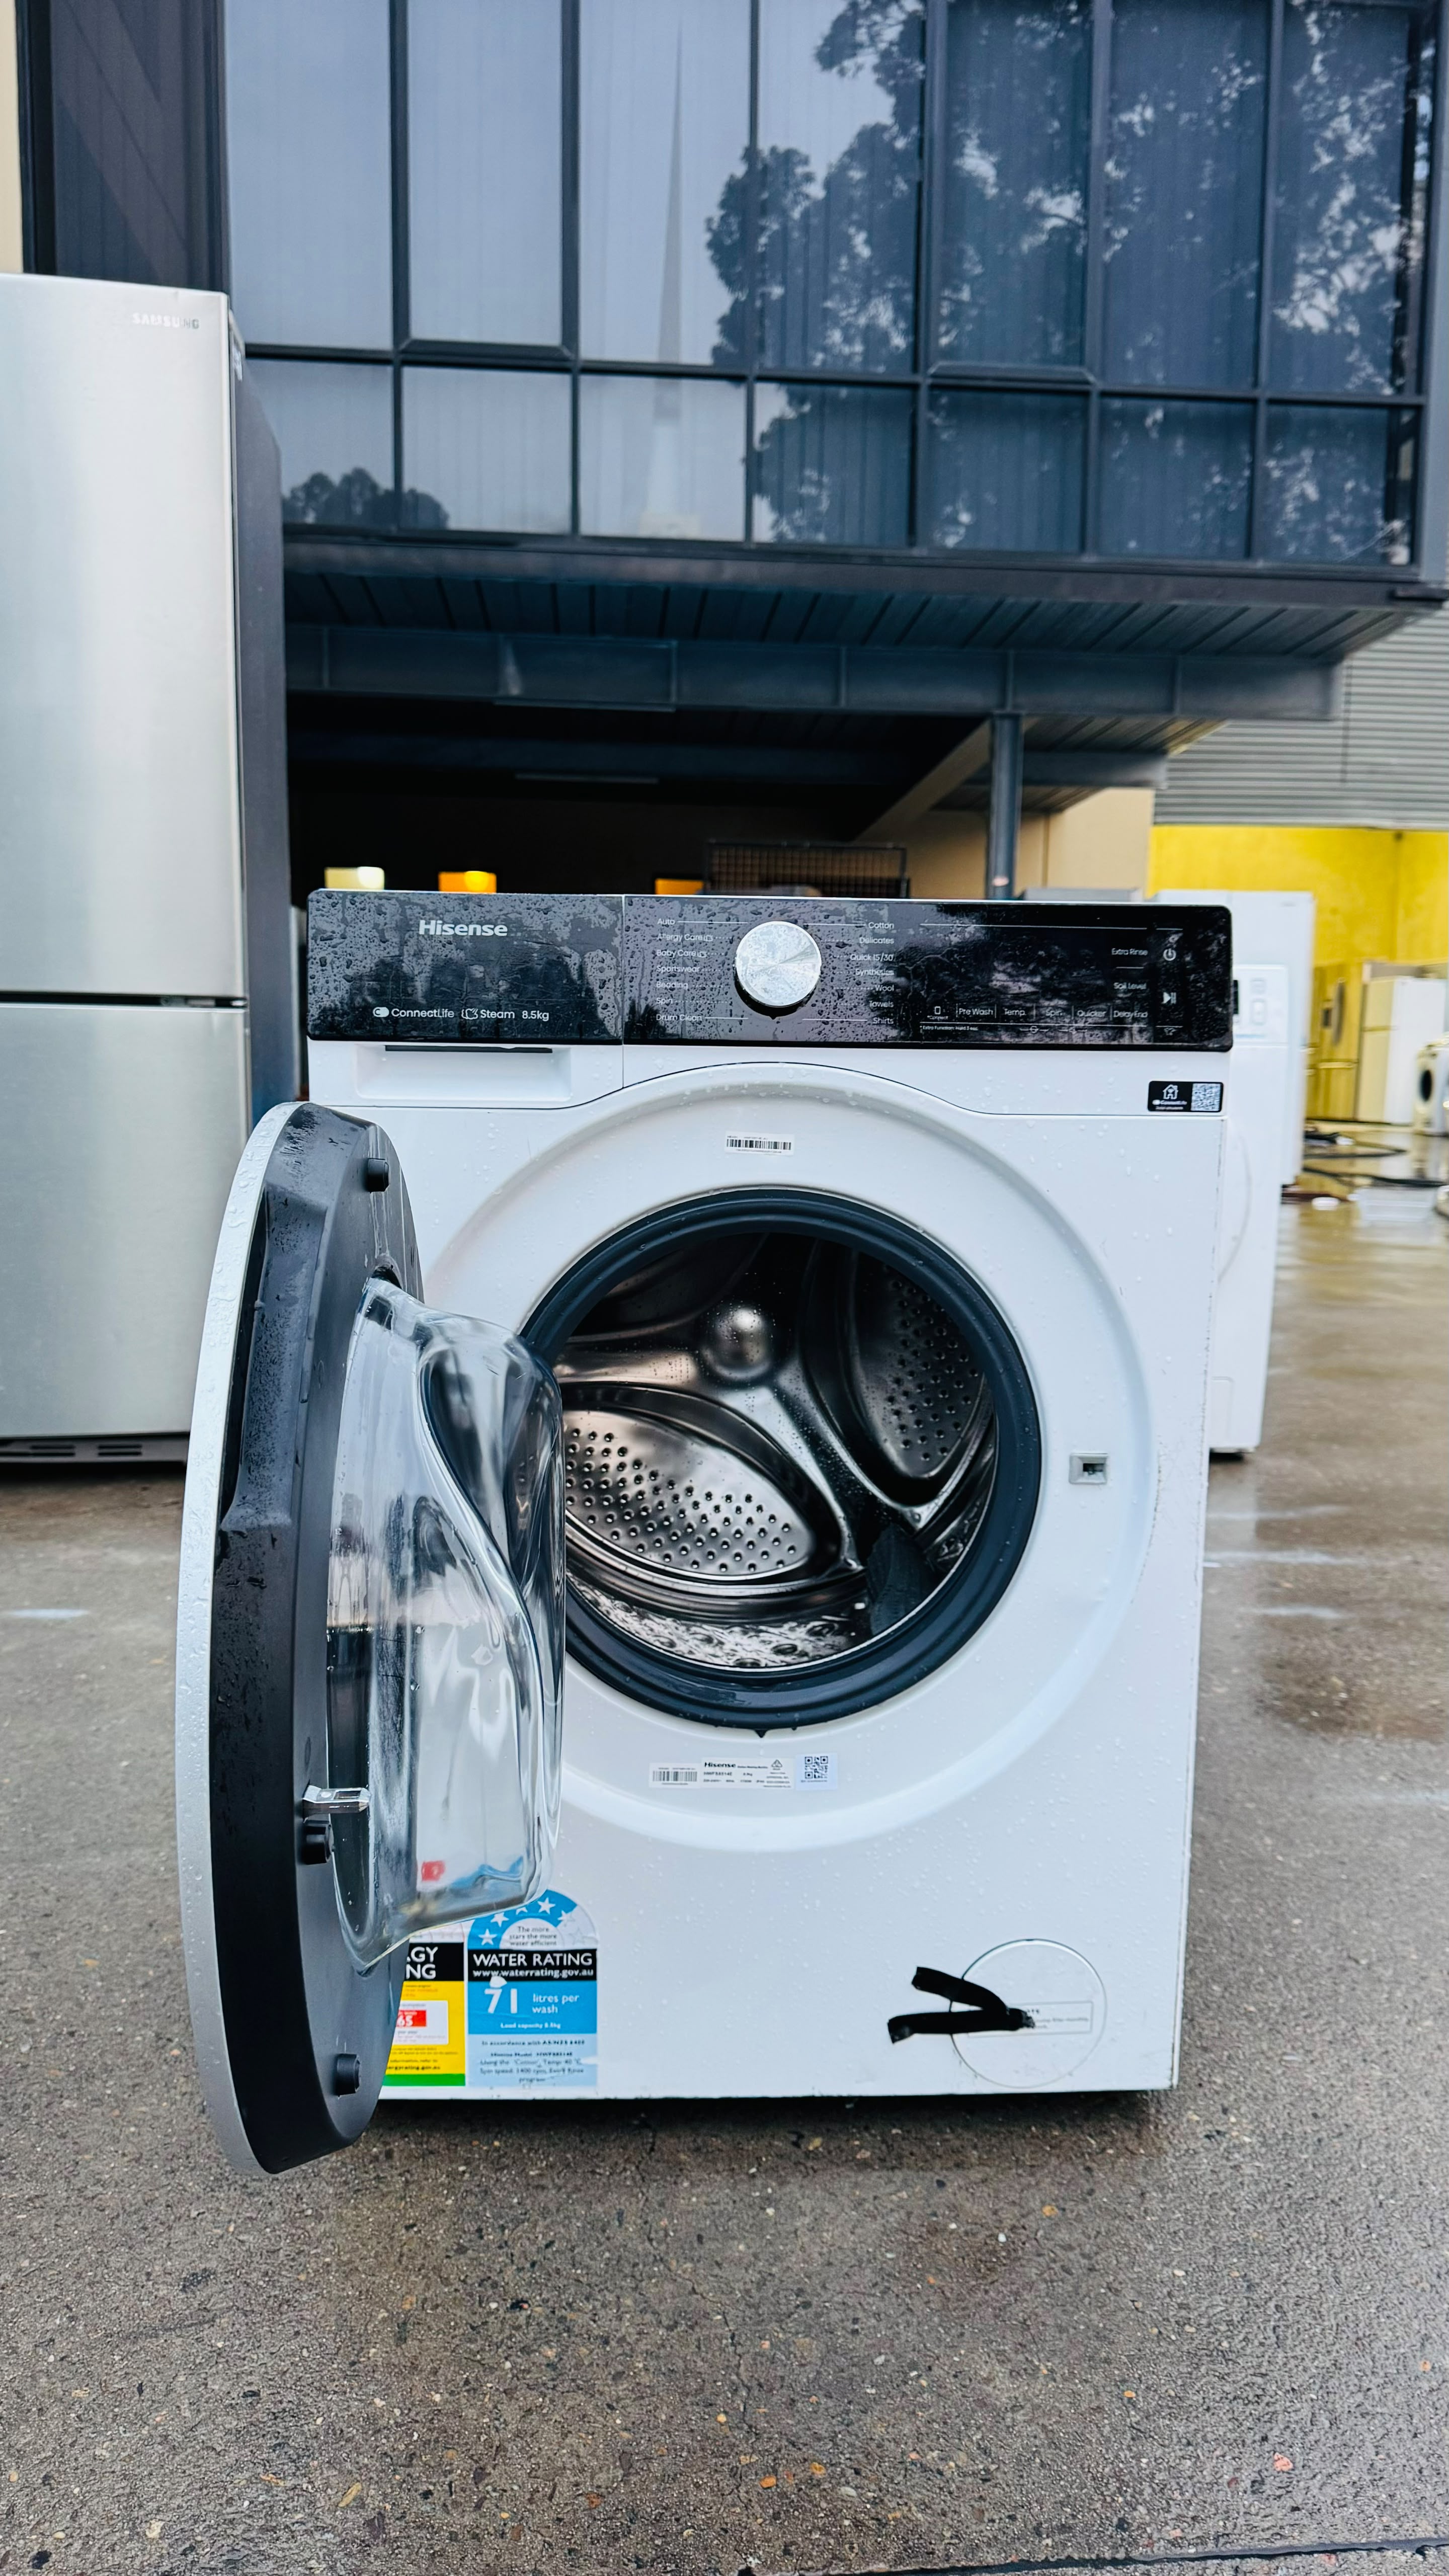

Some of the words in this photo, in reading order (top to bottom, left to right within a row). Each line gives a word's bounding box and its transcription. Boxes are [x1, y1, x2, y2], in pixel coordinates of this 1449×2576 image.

[133, 312, 199, 330] SAMSUNG
[419, 919, 508, 936] Hisense
[657, 949, 676, 957] Baby
[657, 965, 700, 974] Sportswear
[656, 981, 689, 990] Bedding
[391, 1008, 455, 1018] ConnectLife
[480, 1009, 515, 1019] Steam
[522, 1010, 549, 1021] 8.5kg
[407, 1946, 439, 1963] GY
[473, 1953, 528, 1967] WATER
[532, 1953, 593, 1966] RATING
[472, 1968, 594, 1978] www.waterrating.gov.au
[533, 1993, 558, 2003] litres
[561, 1994, 580, 2004] per
[532, 2004, 558, 2014] wash
